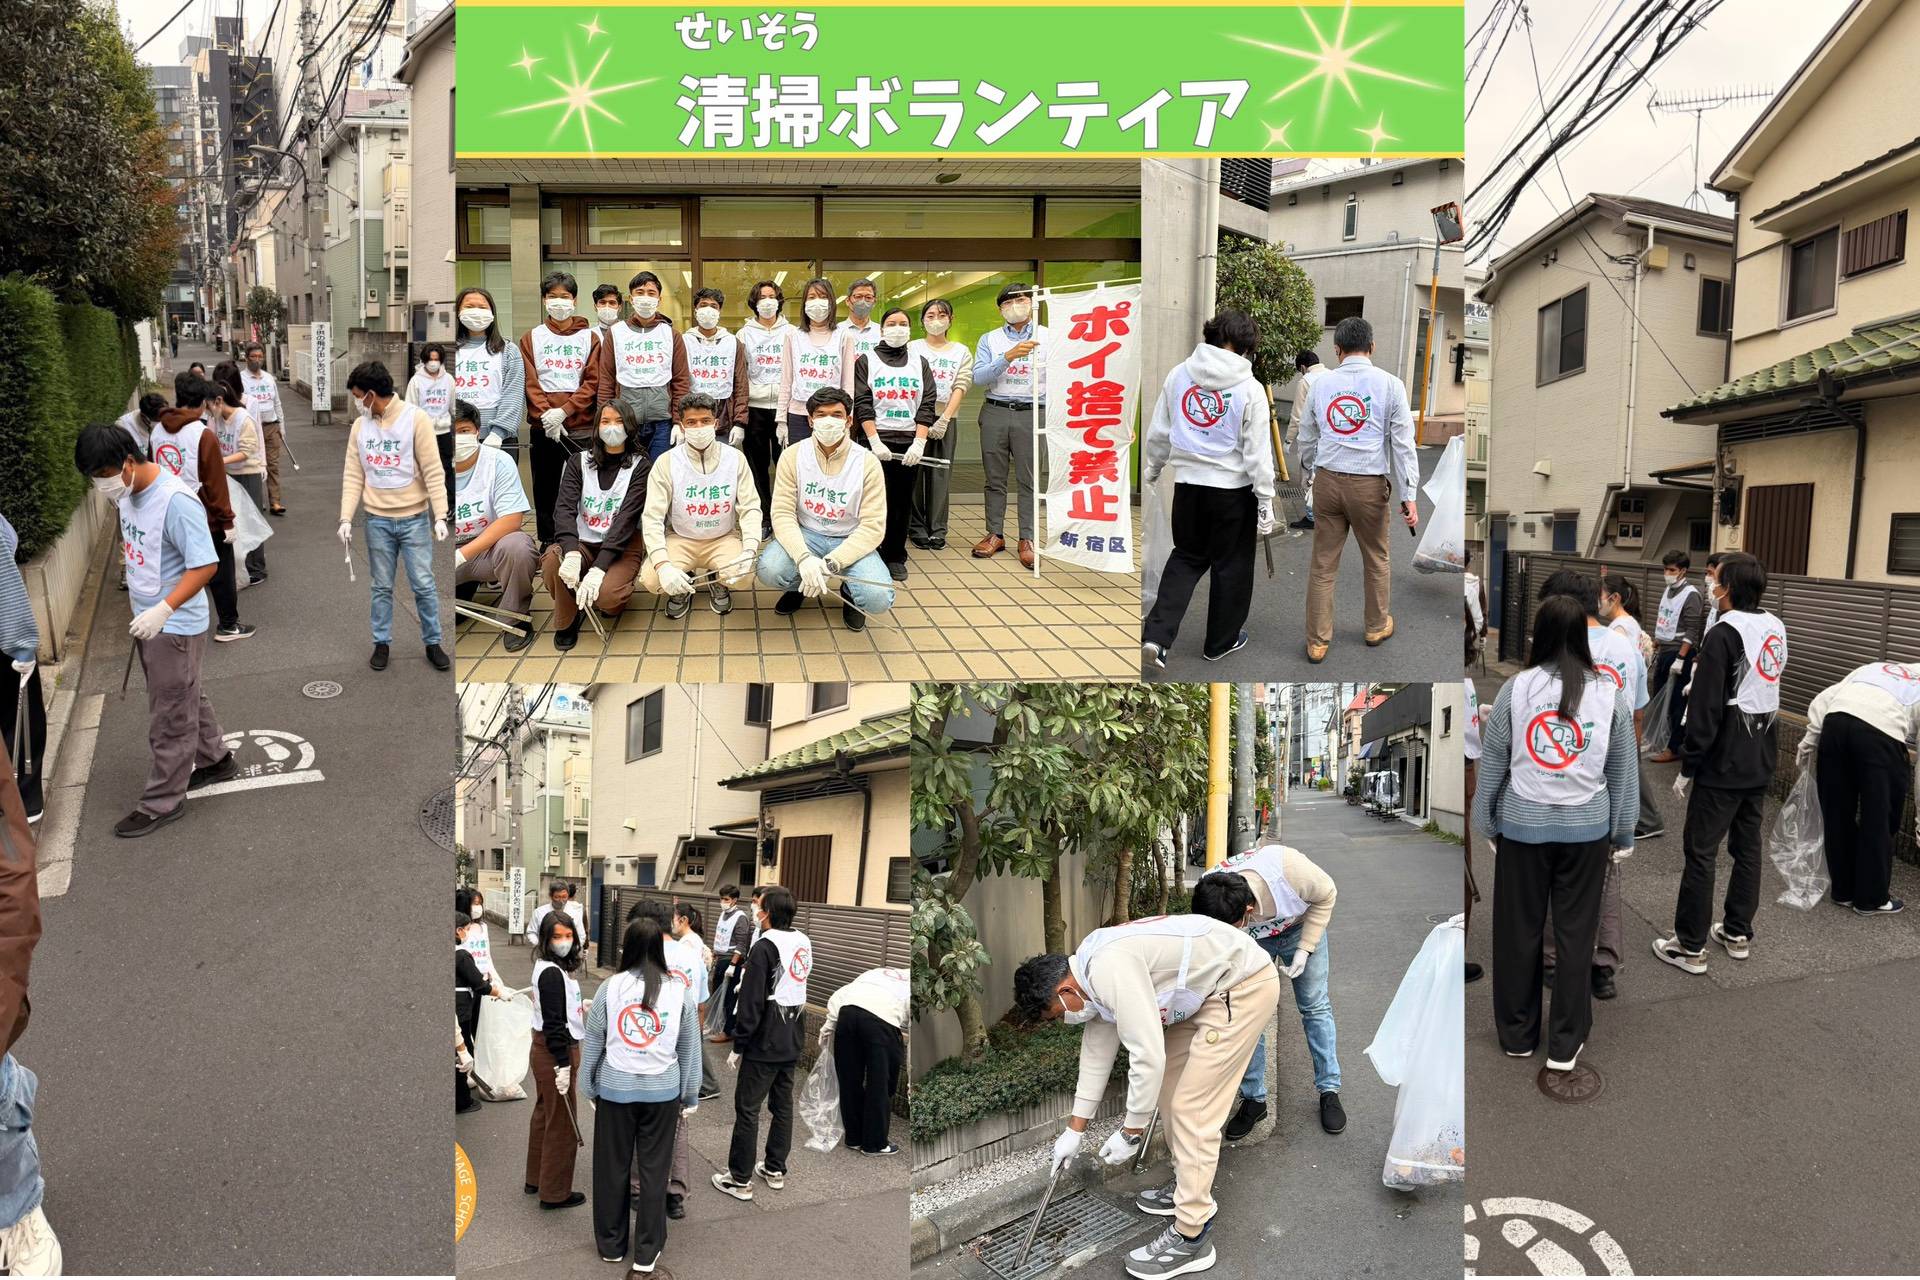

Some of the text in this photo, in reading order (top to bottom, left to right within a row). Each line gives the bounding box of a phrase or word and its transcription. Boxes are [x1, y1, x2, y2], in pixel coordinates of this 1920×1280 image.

[756, 345, 783, 354] ポイ捨
[544, 358, 584, 370] やめよう
[625, 354, 664, 365] やめよう
[756, 355, 782, 365] やめよ
[692, 368, 728, 379] やめよう
[874, 376, 920, 388] ポイ捨て
[1066, 301, 1131, 522] ポイ捨て禁止
[366, 454, 401, 467] やめよう
[684, 484, 731, 500] ポイ捨て
[805, 482, 848, 505] ポイ捨て
[685, 501, 732, 516] やめよう
[1059, 531, 1127, 553] 新宿区
